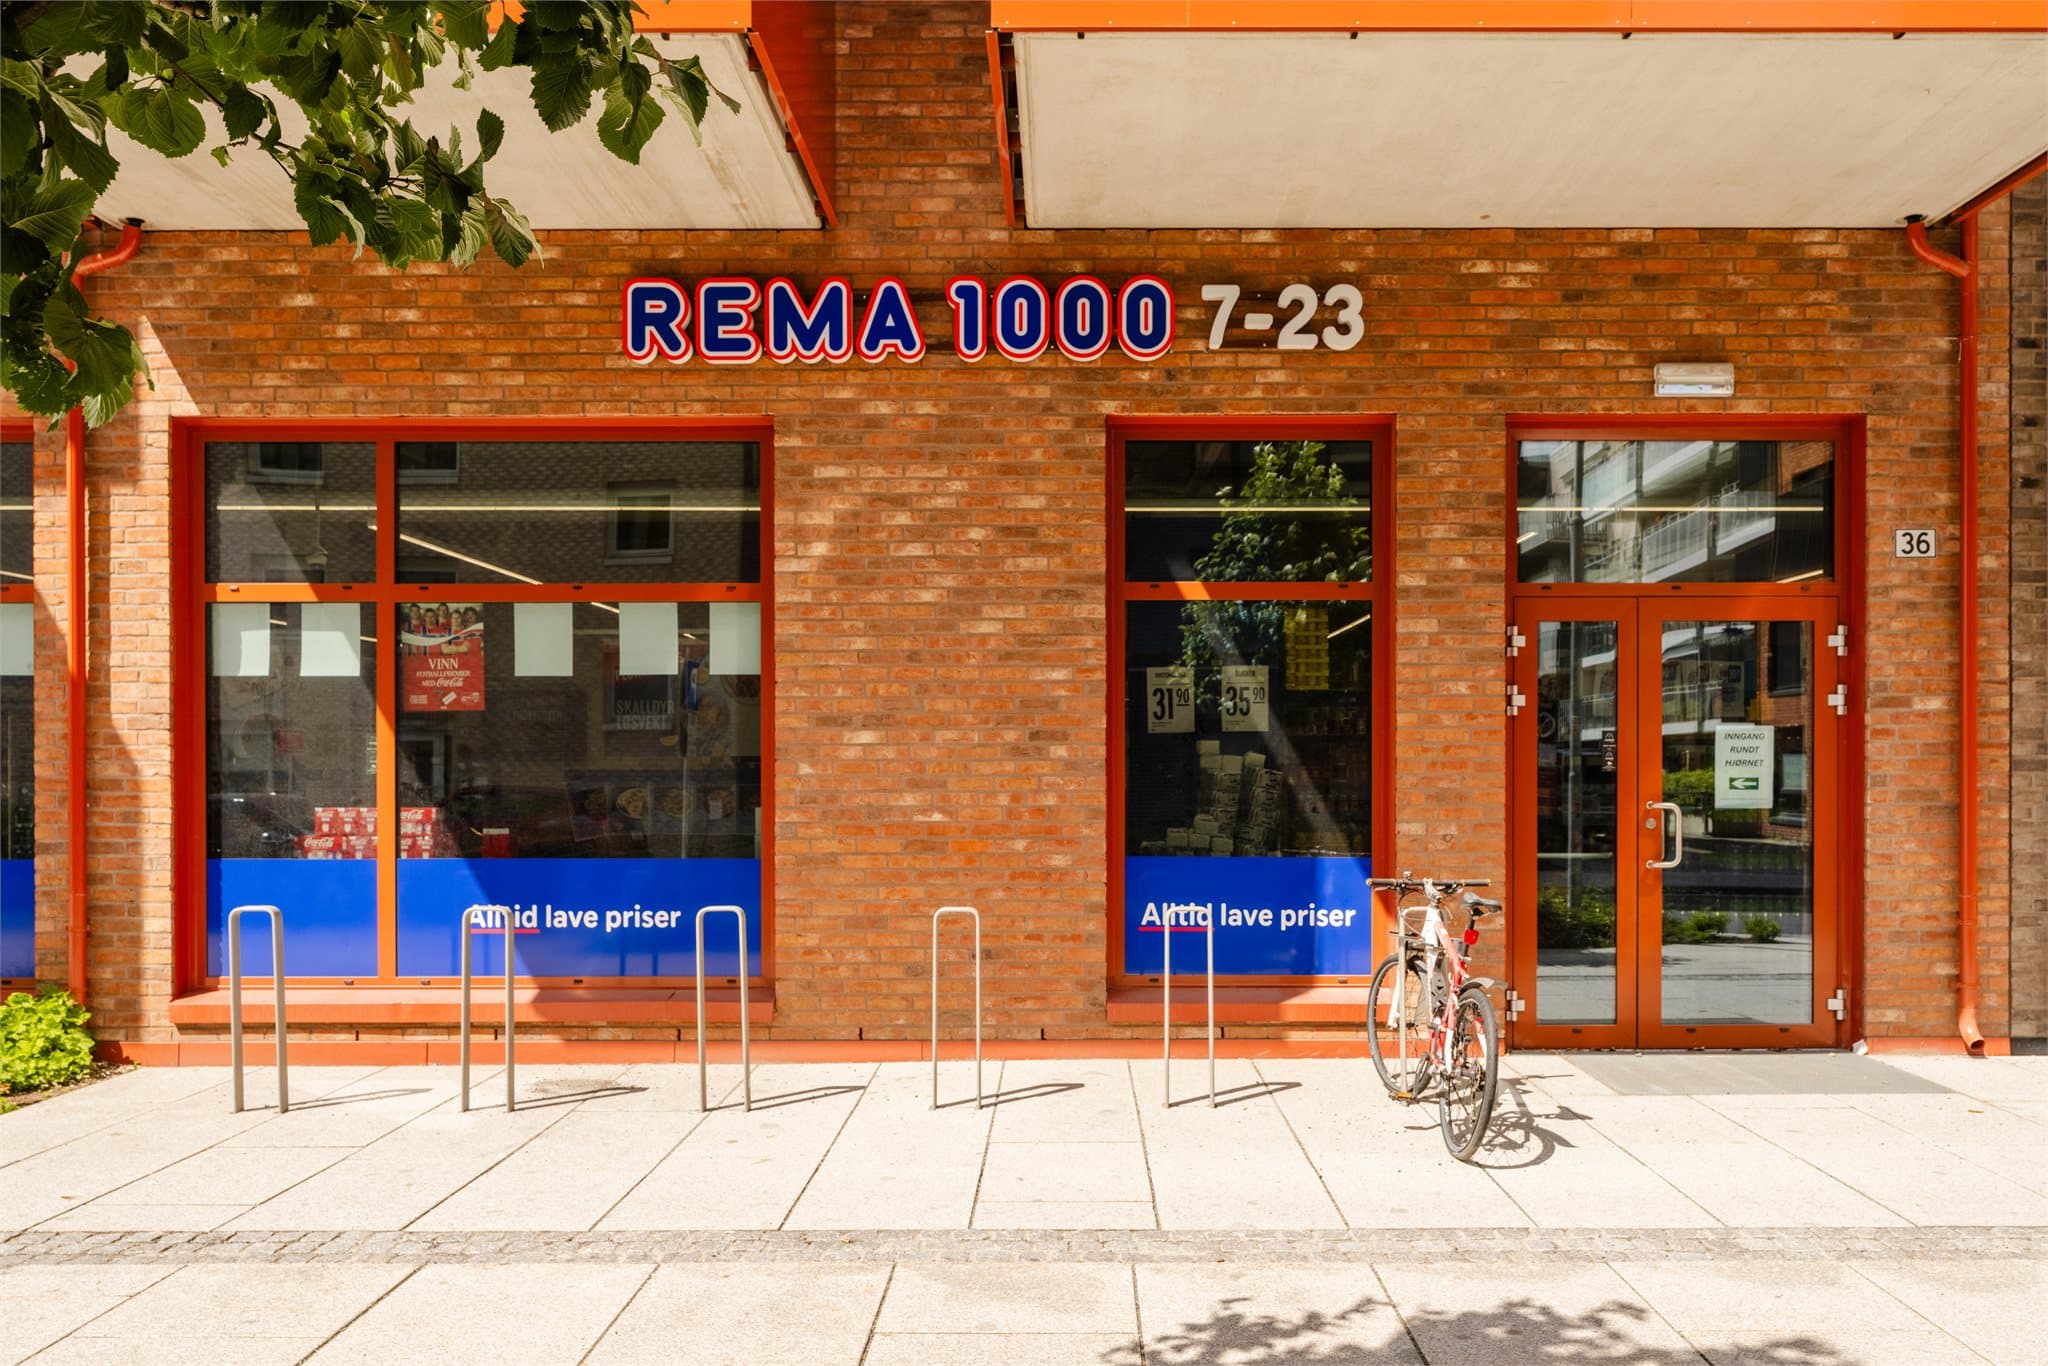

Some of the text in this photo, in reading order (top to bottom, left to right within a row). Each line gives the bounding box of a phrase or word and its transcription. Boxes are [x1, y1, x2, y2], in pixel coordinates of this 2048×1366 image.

[623, 275, 1365, 363] REMA 1000 7-23
[1901, 532, 1931, 554] 36
[428, 658, 458, 670] VINN
[545, 904, 599, 929] lave
[606, 904, 681, 933] priser
[1221, 903, 1274, 927] lave
[1281, 903, 1357, 931] priser
